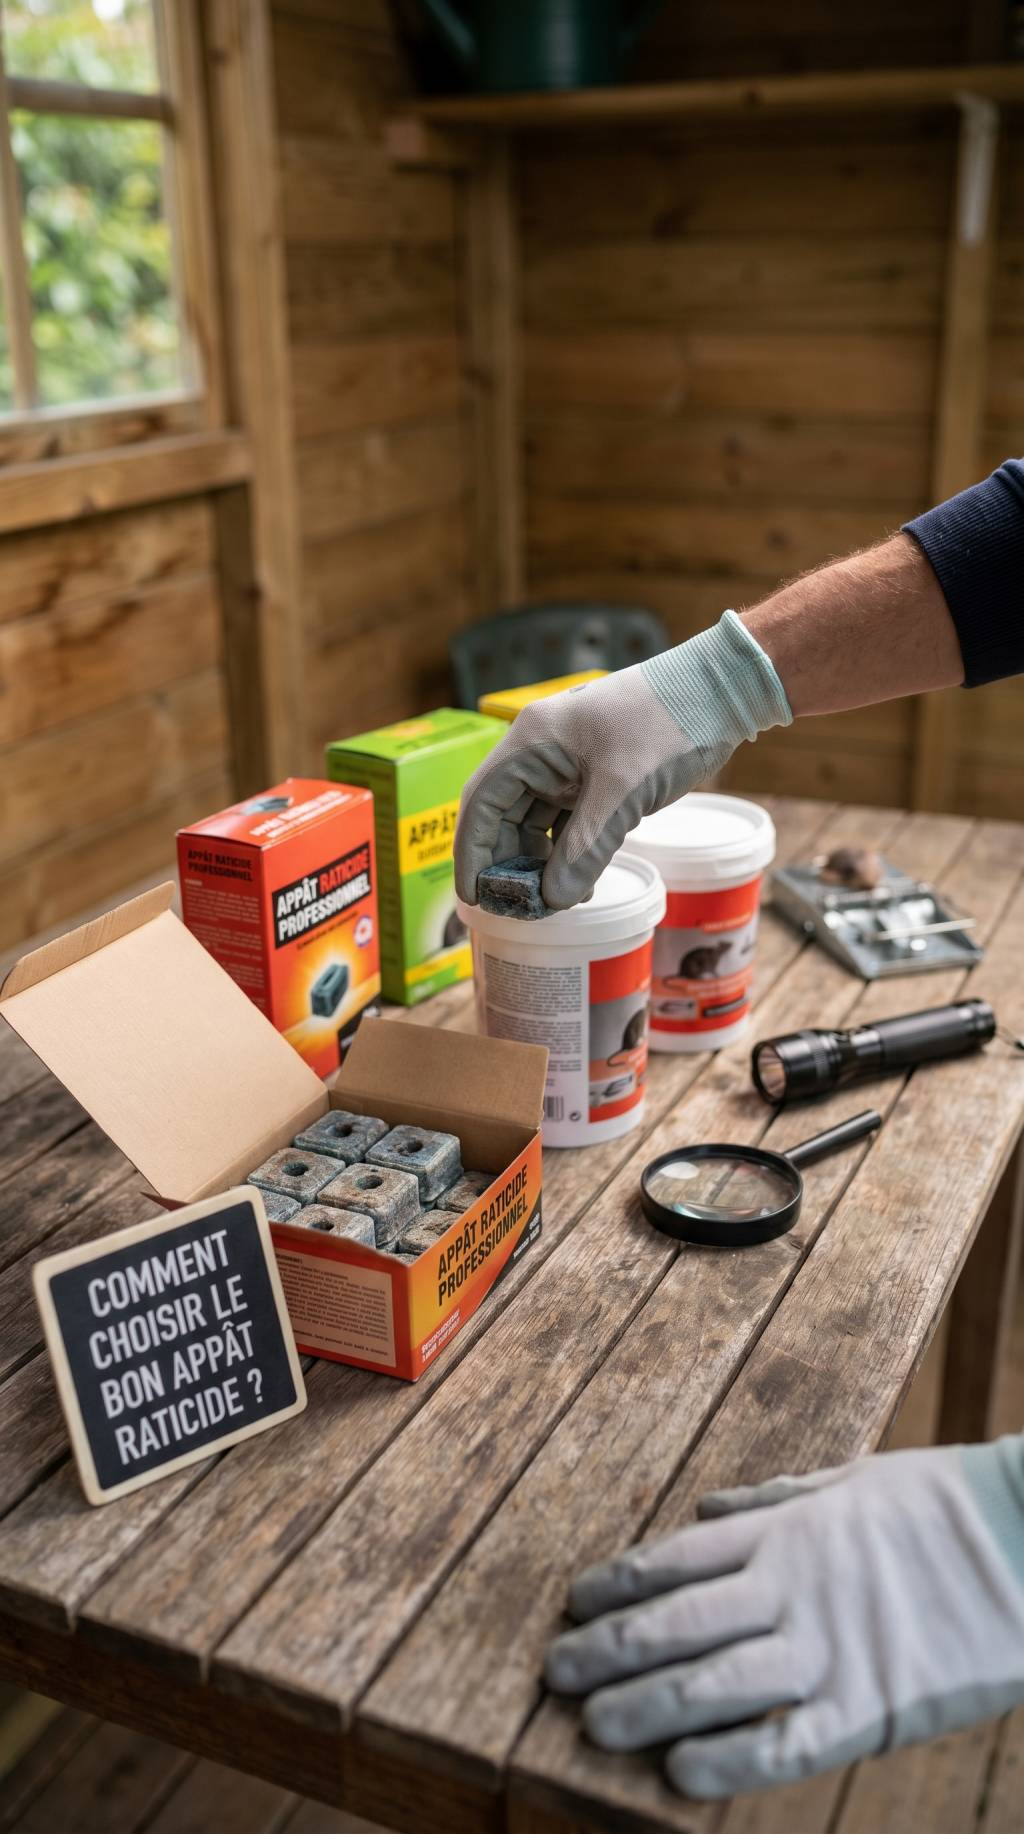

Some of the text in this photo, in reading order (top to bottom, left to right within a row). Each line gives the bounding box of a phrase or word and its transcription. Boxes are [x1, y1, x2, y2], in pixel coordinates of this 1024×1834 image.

[188, 862, 253, 881] PROFESSIONNEL
[215, 854, 252, 870] RATICIDE
[277, 877, 318, 918] APPÂT
[319, 849, 369, 895] RATICIDE
[278, 872, 371, 941] PROFESSIONNEL
[438, 1219, 477, 1281] APPÂT
[480, 1163, 528, 1236] RATICIDE
[438, 1193, 528, 1307] PROFESSIONNEL
[87, 1230, 229, 1318] COMMENT
[89, 1293, 208, 1370] CHOISIR
[210, 1274, 248, 1320] LE
[100, 1360, 165, 1419] BON
[173, 1320, 254, 1390] APPÂT
[114, 1367, 264, 1466] RATICIDE ?
